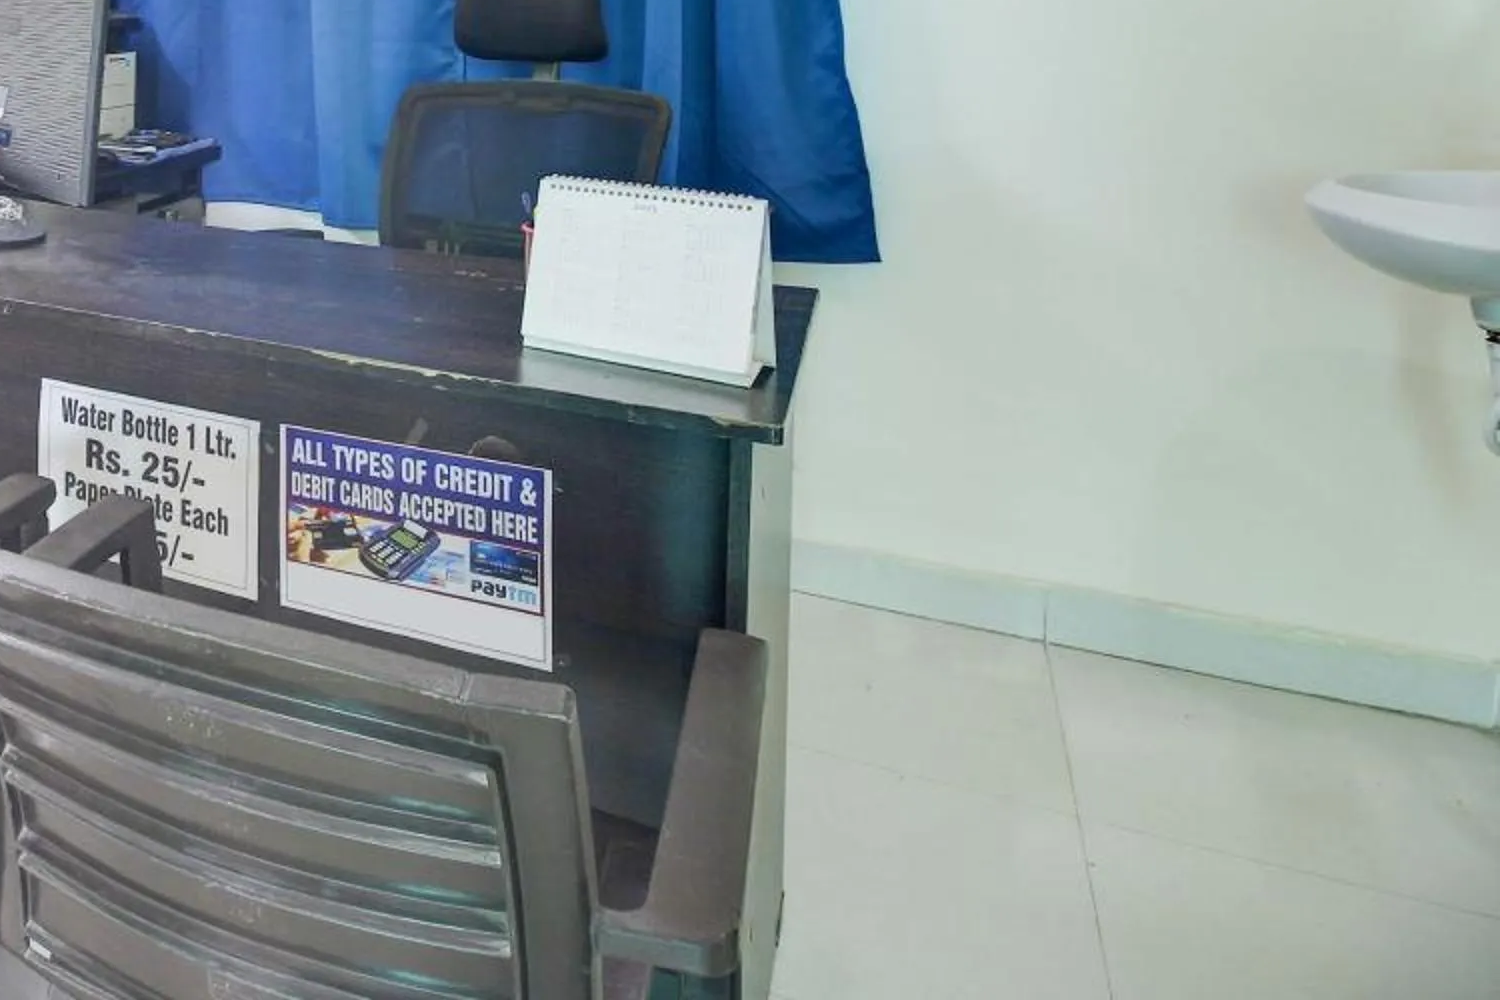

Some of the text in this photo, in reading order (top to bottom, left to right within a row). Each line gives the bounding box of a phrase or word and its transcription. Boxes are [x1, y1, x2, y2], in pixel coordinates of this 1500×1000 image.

[61, 396, 237, 459] Water Bottle 1 Ltr.
[85, 438, 205, 493] Rs. 25/-
[291, 437, 537, 507] ALL TYPES OF CREDIT &
[180, 499, 229, 536] Each
[291, 470, 539, 544] DEBIT CARDS ACCEPTED HERE
